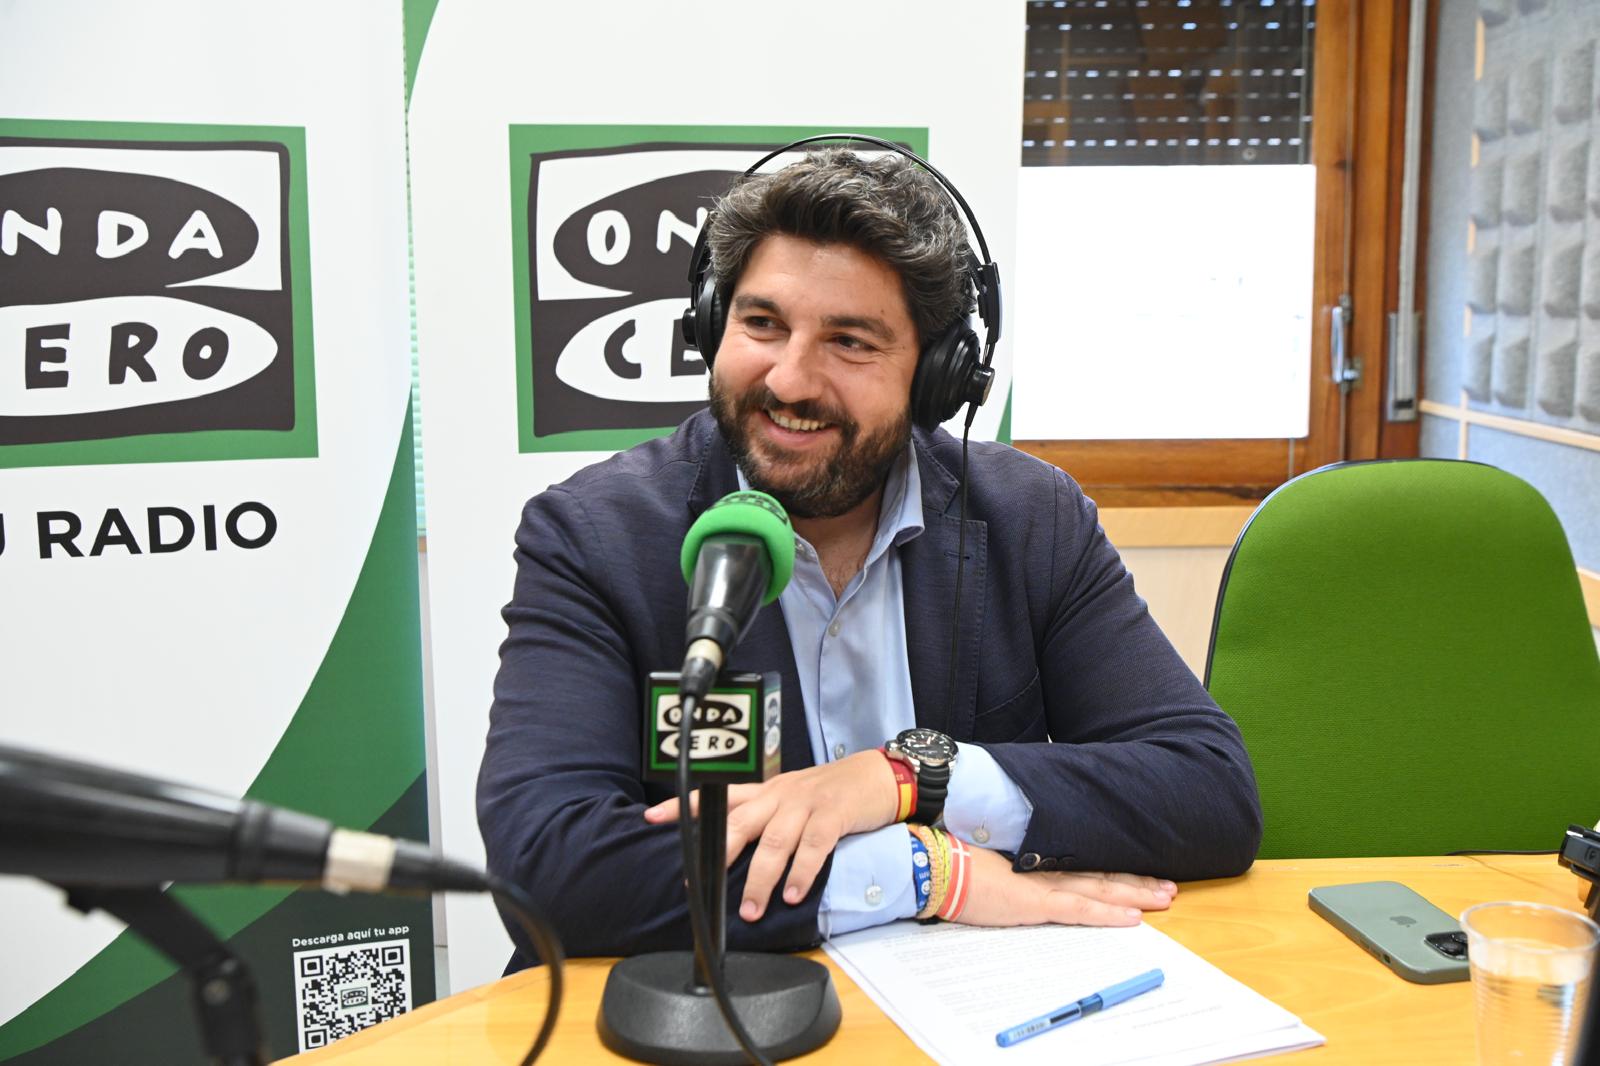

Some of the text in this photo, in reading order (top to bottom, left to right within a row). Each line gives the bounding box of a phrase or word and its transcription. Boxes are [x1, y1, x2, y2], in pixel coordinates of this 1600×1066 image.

[37, 502, 277, 558] RADIO
[292, 926, 410, 948] Descarga aquí tu app
